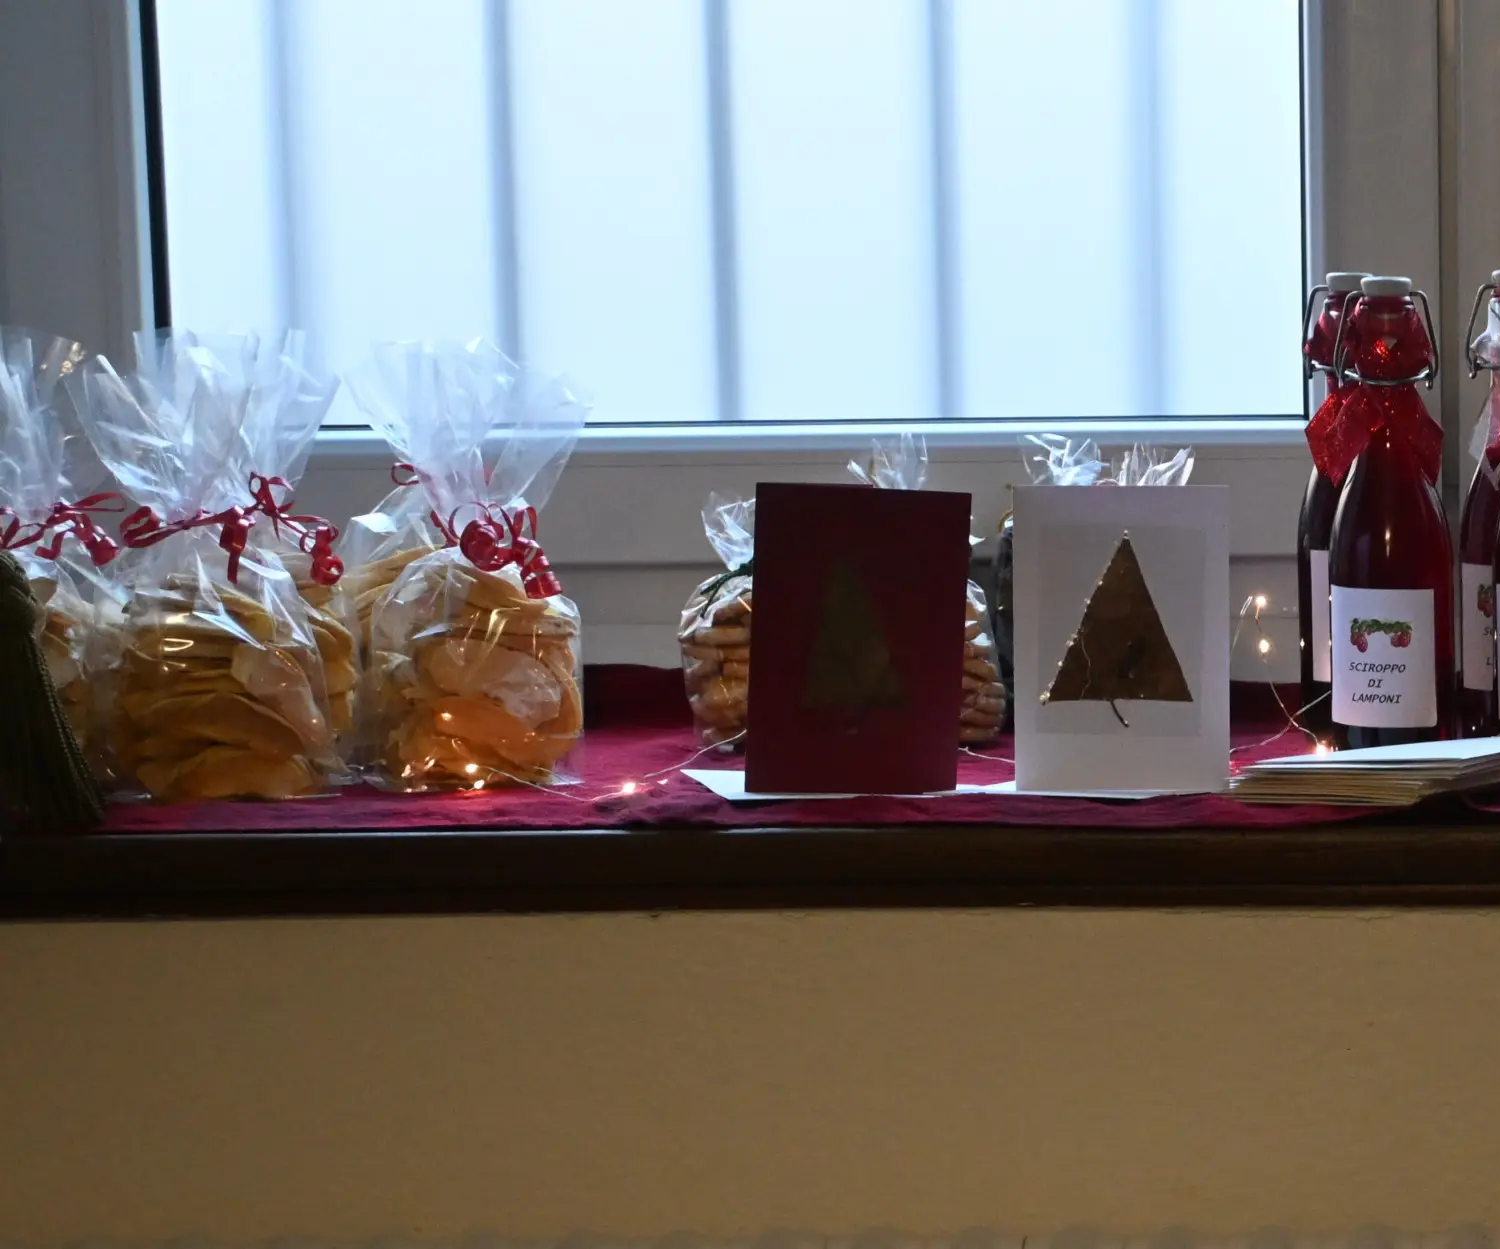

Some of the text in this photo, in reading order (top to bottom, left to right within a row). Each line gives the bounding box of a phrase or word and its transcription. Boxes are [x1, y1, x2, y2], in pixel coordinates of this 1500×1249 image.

[1348, 661, 1407, 674] SCIROPPO
[1367, 678, 1384, 689] DI
[1351, 692, 1402, 704] LAMPONI
